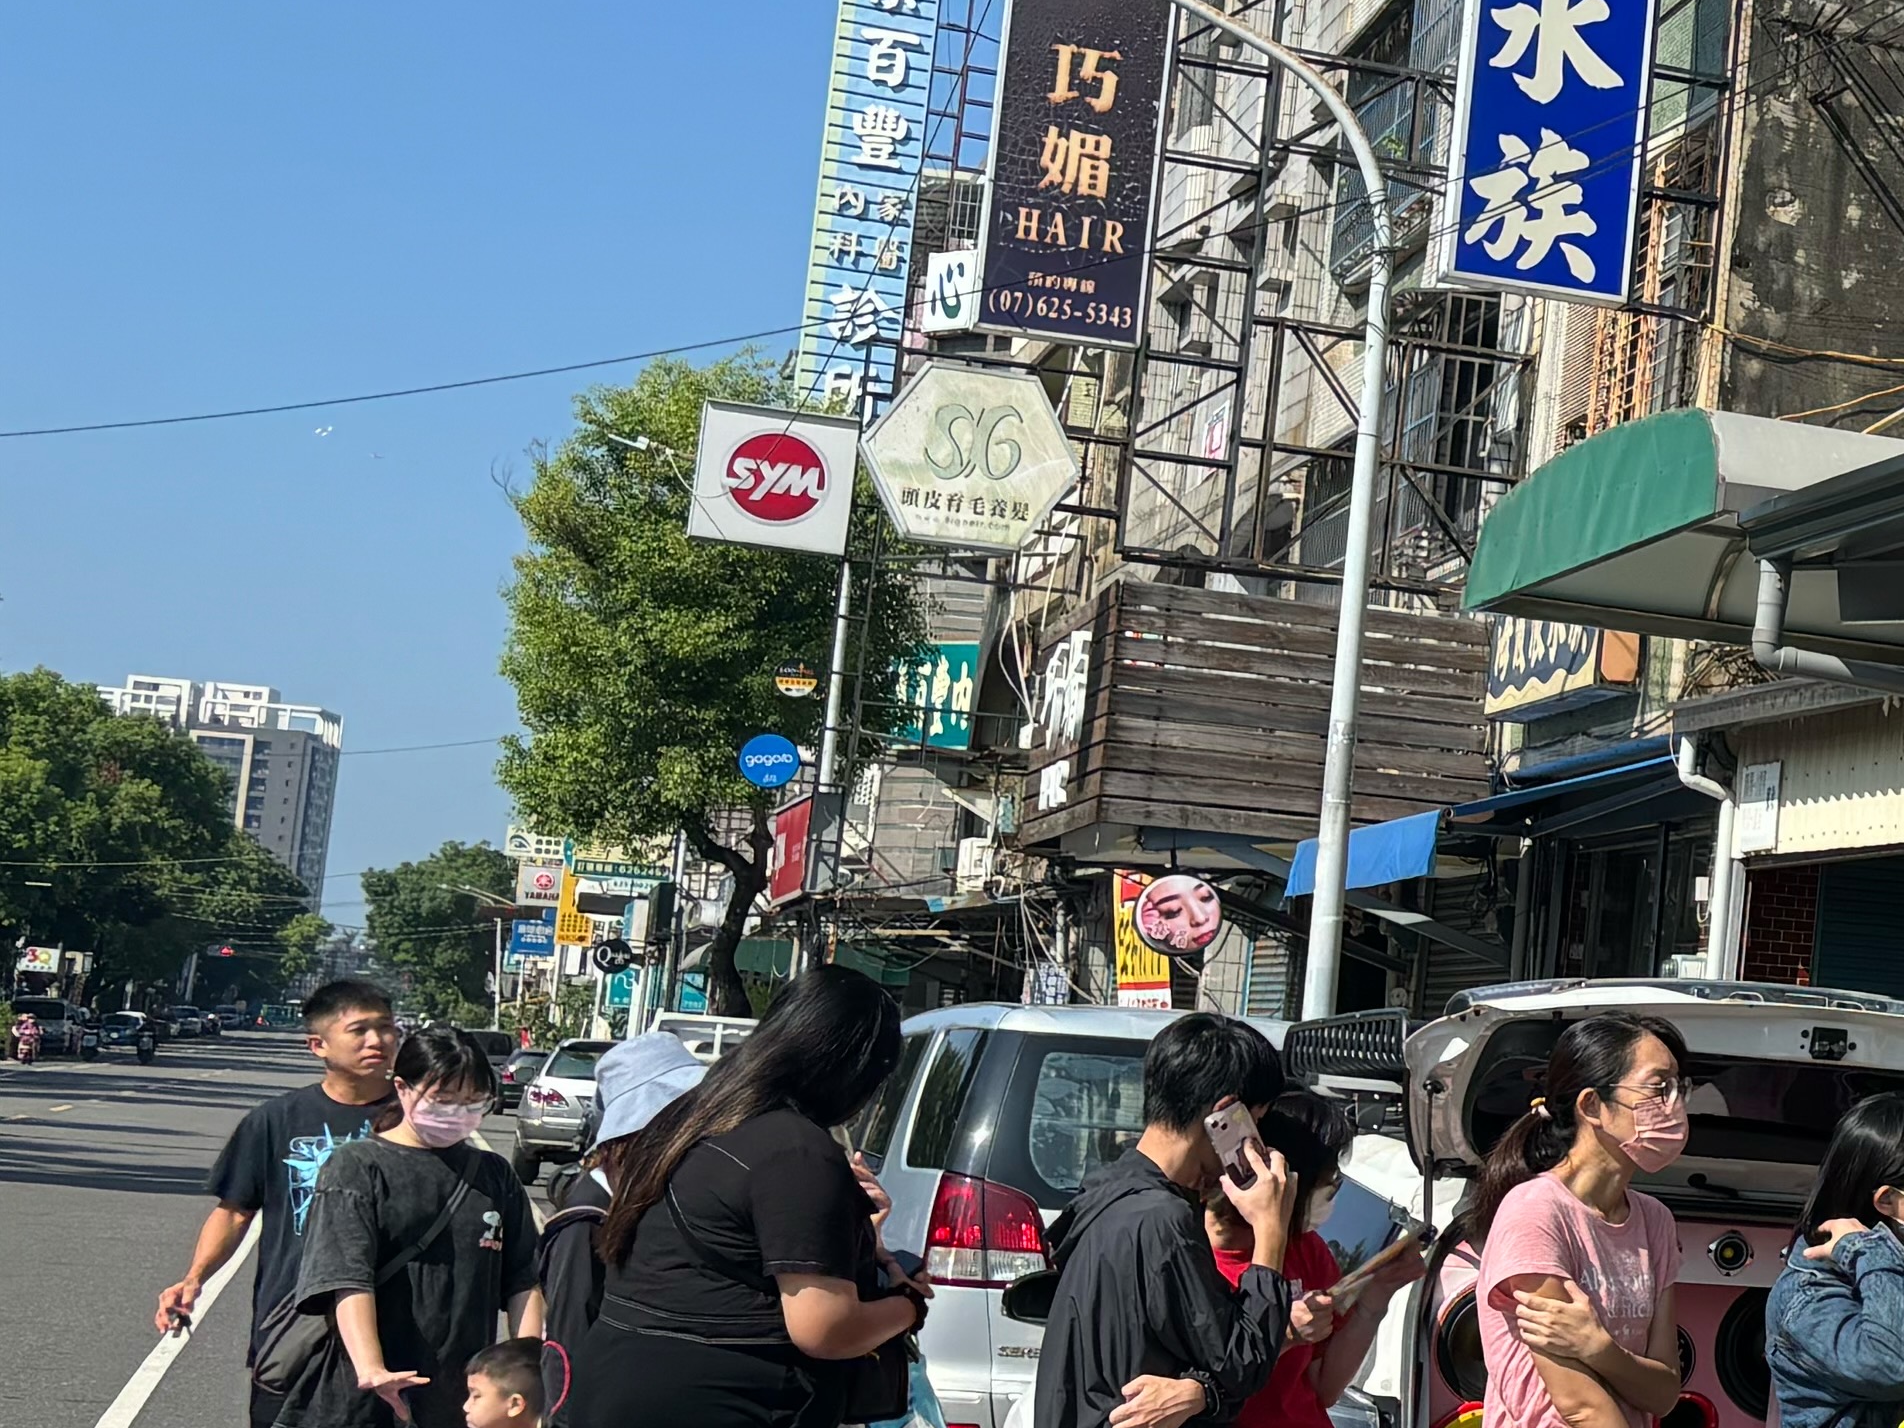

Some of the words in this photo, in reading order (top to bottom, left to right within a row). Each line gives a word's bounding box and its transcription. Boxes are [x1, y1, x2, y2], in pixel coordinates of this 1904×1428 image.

[1041, 42, 1122, 201] 巧媚
[1015, 206, 1125, 255] HAIR
[988, 288, 1133, 330] (07)625-5343
[727, 454, 828, 502] SYM
[901, 486, 1030, 522] 頭皮育毛養髮
